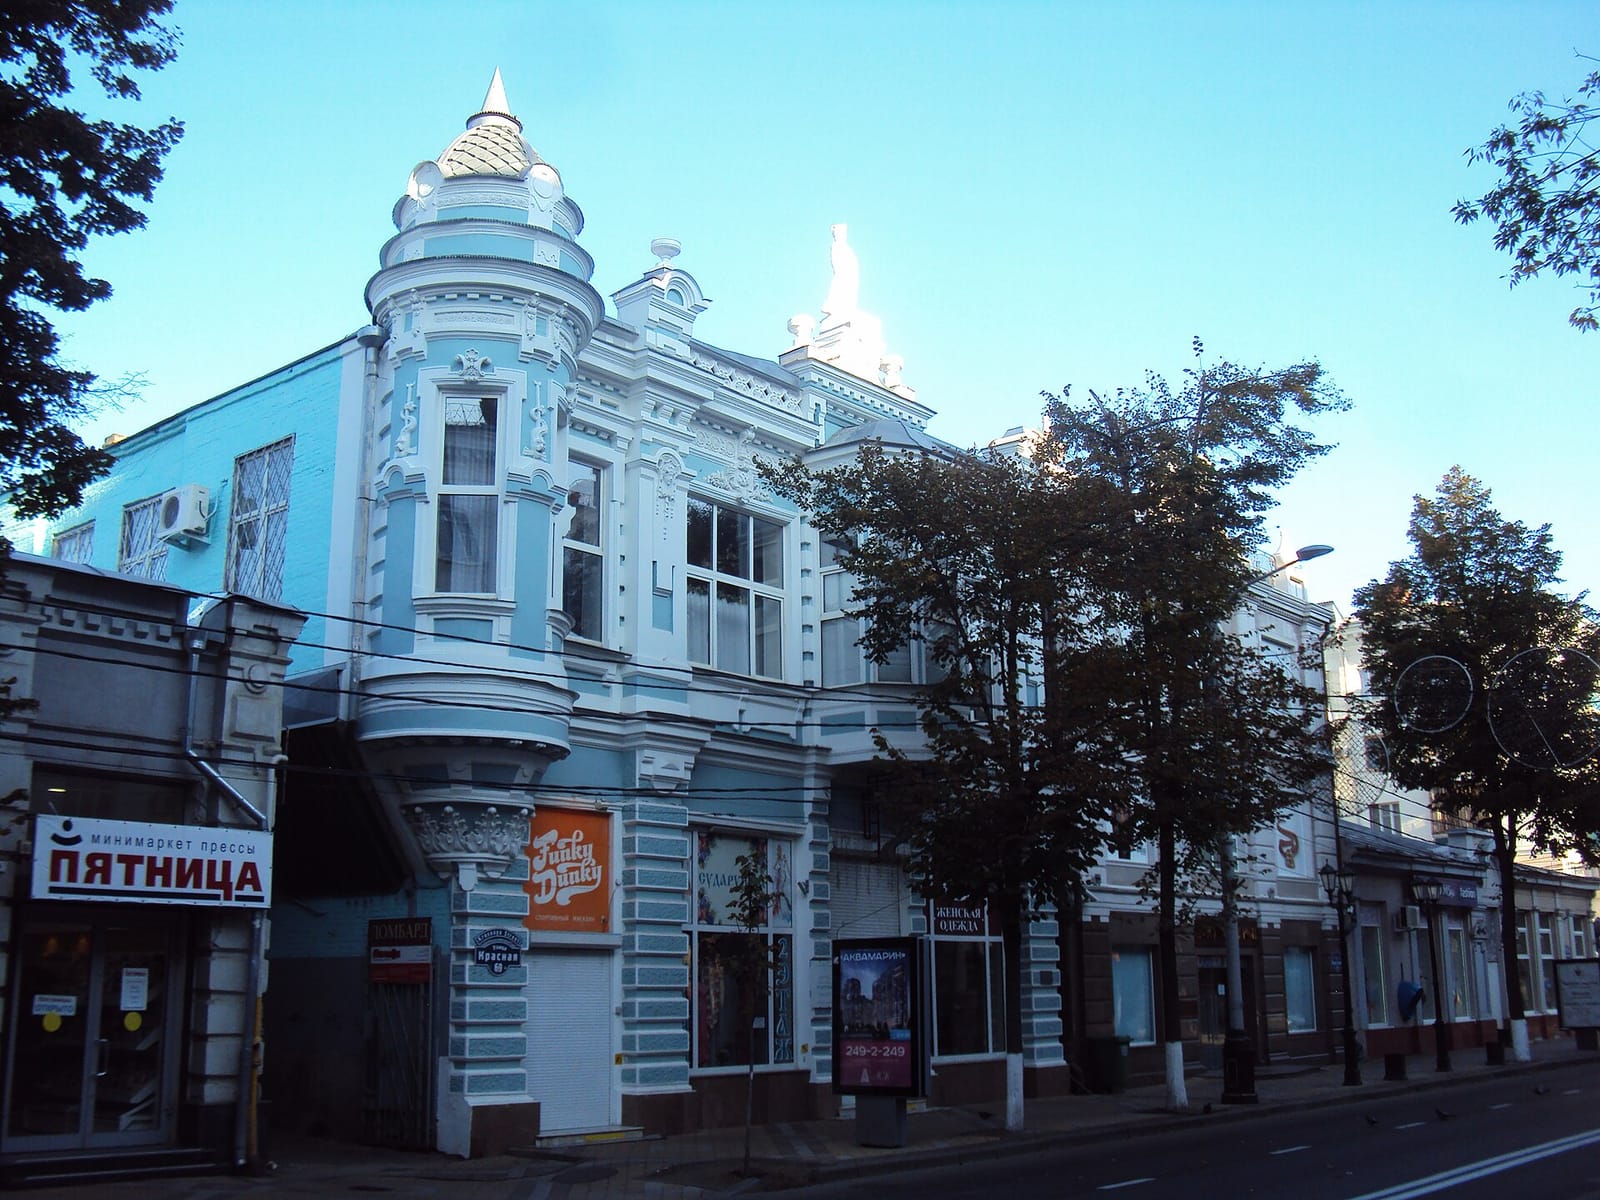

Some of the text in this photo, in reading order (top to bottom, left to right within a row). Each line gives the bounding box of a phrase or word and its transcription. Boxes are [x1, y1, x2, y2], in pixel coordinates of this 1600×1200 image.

[91, 833, 255, 855] минимаркет прессы
[533, 829, 594, 871] Funky
[49, 849, 263, 902] ПЯТНИЦА
[532, 858, 602, 906] Dunky
[936, 906, 981, 919] ЖЕНСКАЯ
[939, 919, 979, 933] ОДЕЖДА
[478, 950, 518, 962] Красная
[845, 1045, 905, 1057] 249-2-249
